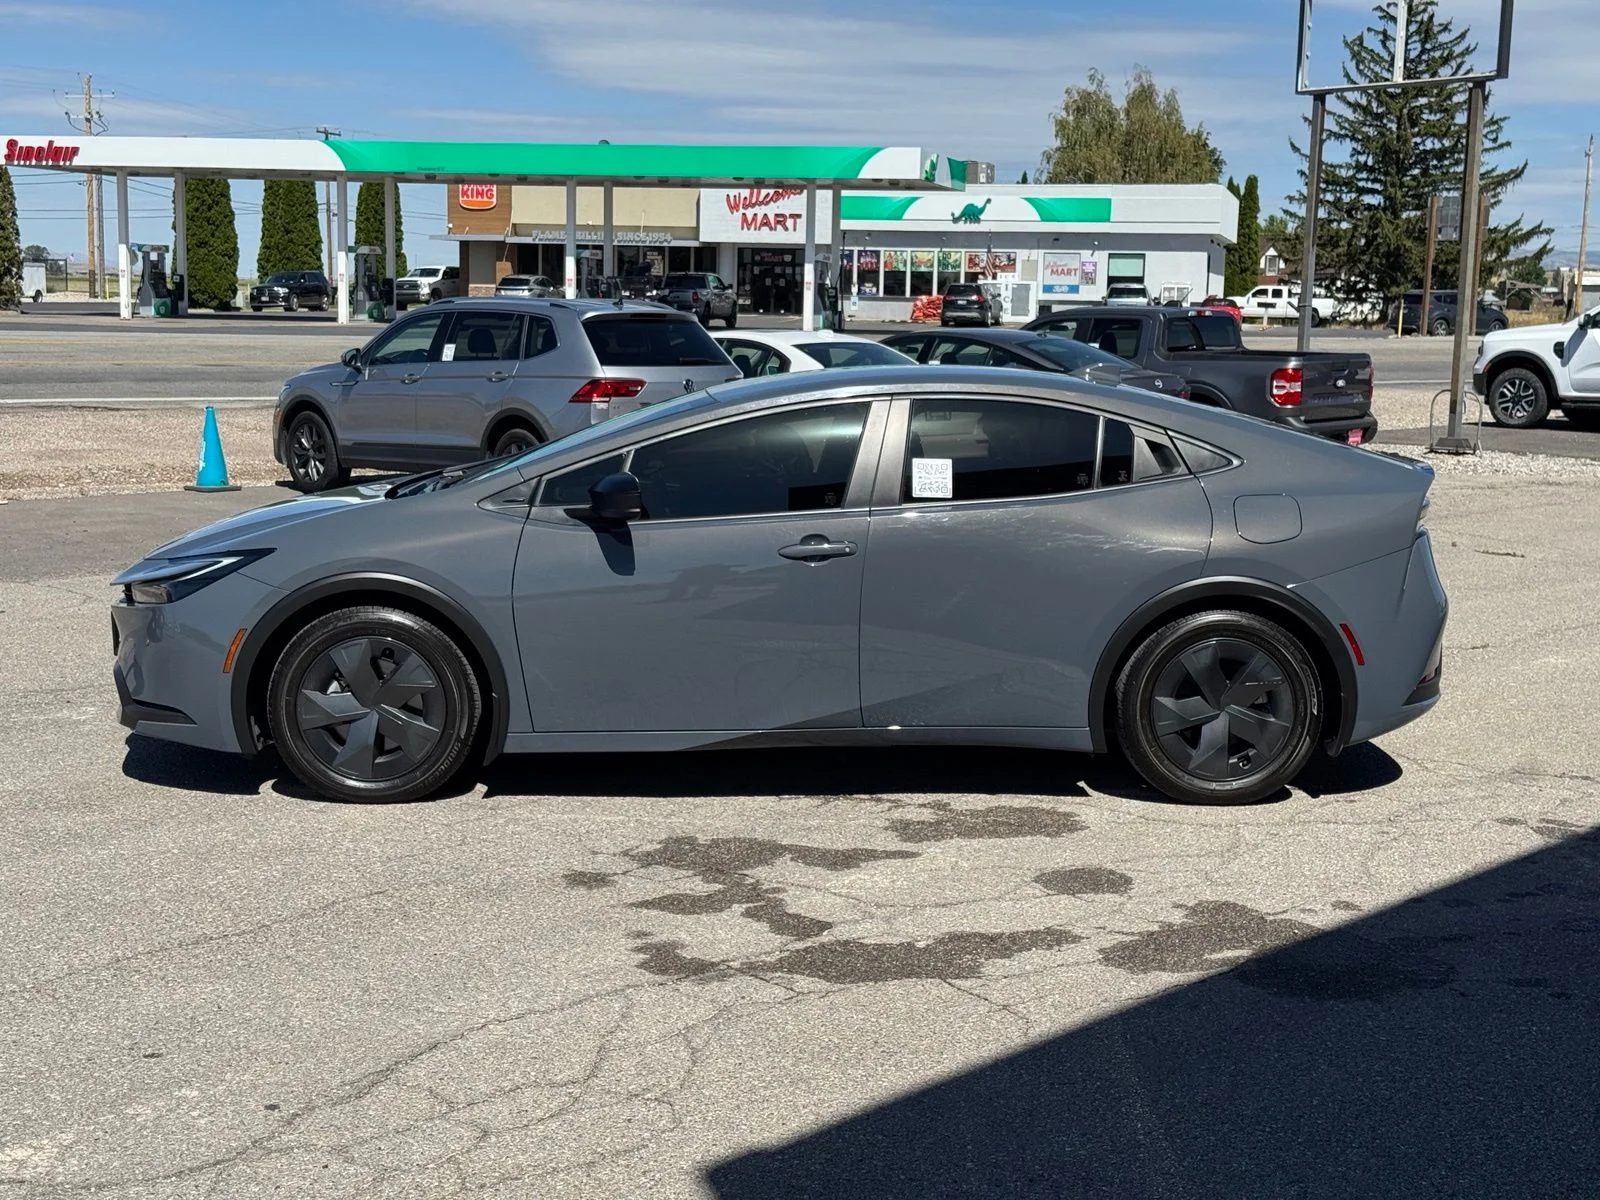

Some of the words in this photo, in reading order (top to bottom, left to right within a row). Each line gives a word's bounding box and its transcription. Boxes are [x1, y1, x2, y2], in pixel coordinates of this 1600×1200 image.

[4, 139, 80, 164] Sinclair
[461, 188, 494, 199] KING
[741, 212, 802, 232] MART
[617, 231, 647, 242] SINCE
[648, 232, 673, 243] 1954
[1050, 268, 1079, 277] MART
